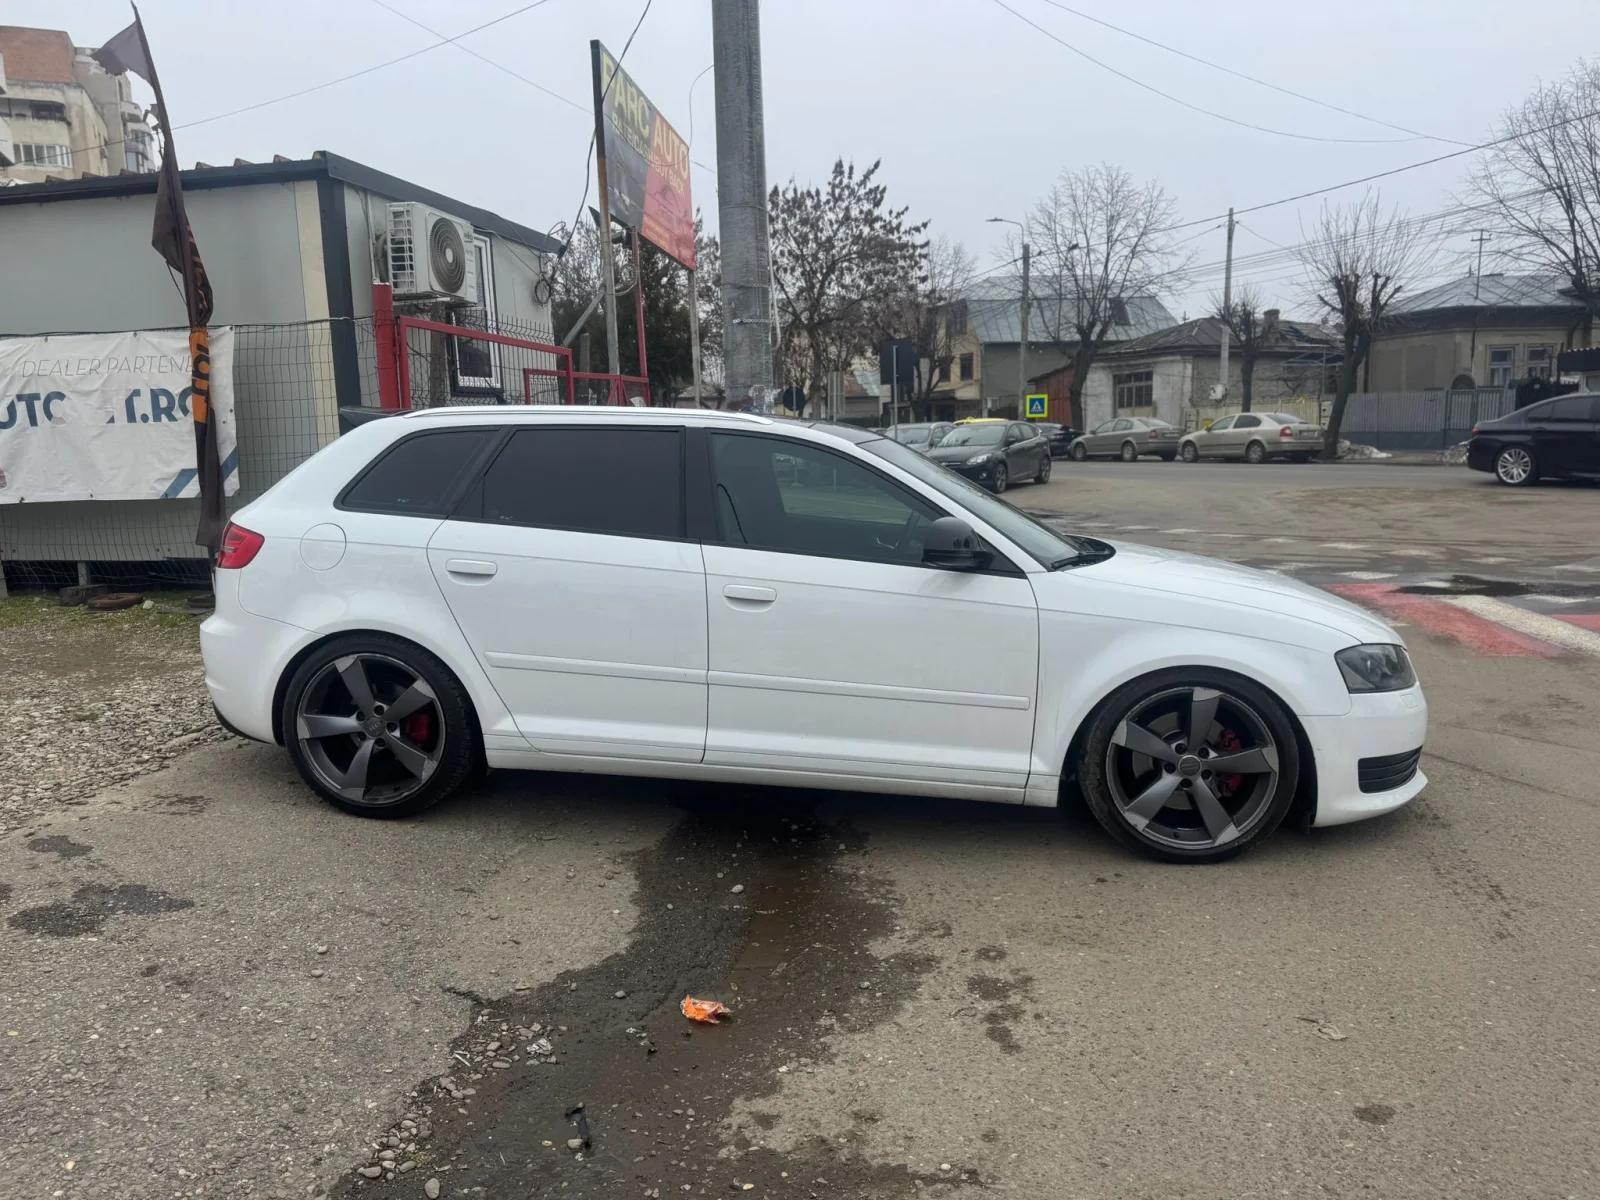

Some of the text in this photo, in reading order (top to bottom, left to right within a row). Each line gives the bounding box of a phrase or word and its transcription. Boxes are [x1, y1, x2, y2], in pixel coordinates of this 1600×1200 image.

[602, 51, 650, 138] PARC
[654, 114, 689, 180] AUTO
[669, 169, 686, 197] BACK
[21, 358, 100, 378] DEALER
